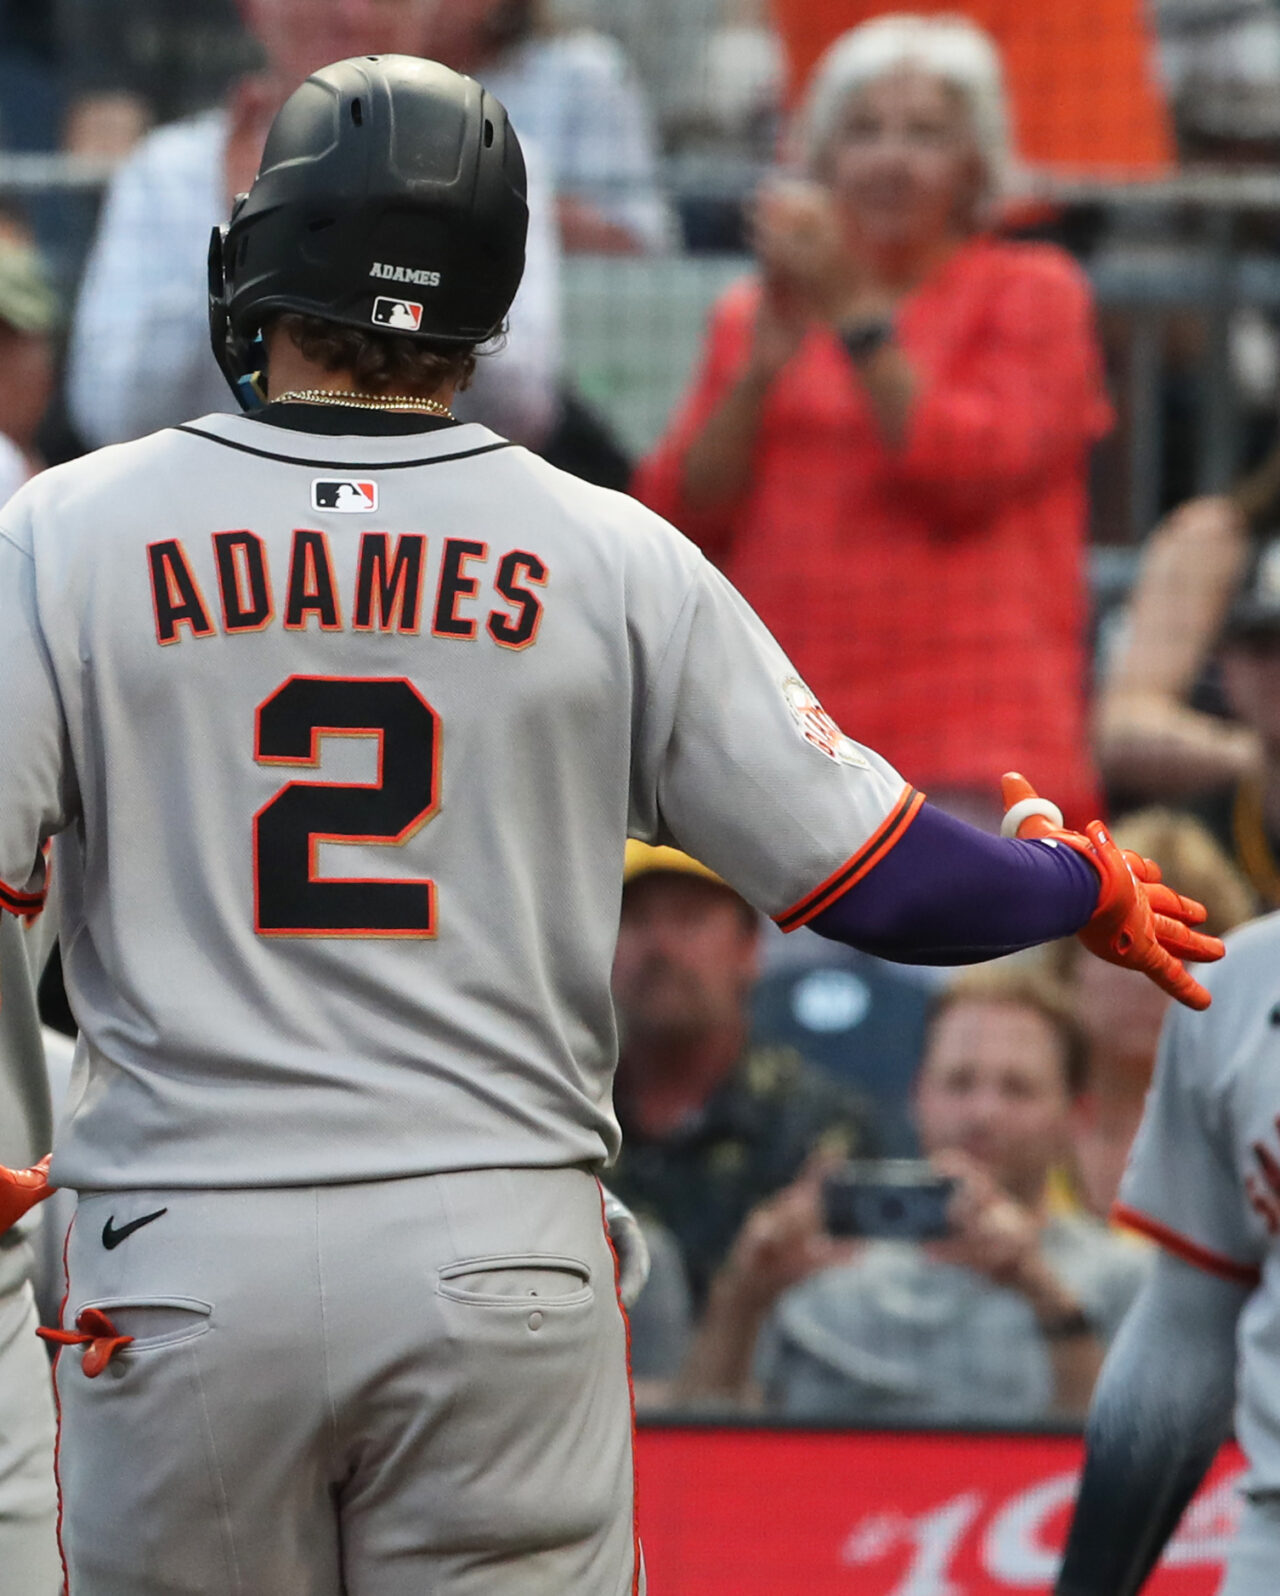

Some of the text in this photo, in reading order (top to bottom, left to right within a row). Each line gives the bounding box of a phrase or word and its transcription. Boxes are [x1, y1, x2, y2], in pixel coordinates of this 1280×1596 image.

[369, 262, 441, 287] ADAMES
[146, 529, 549, 651] ADAMES
[253, 674, 442, 939] 2
